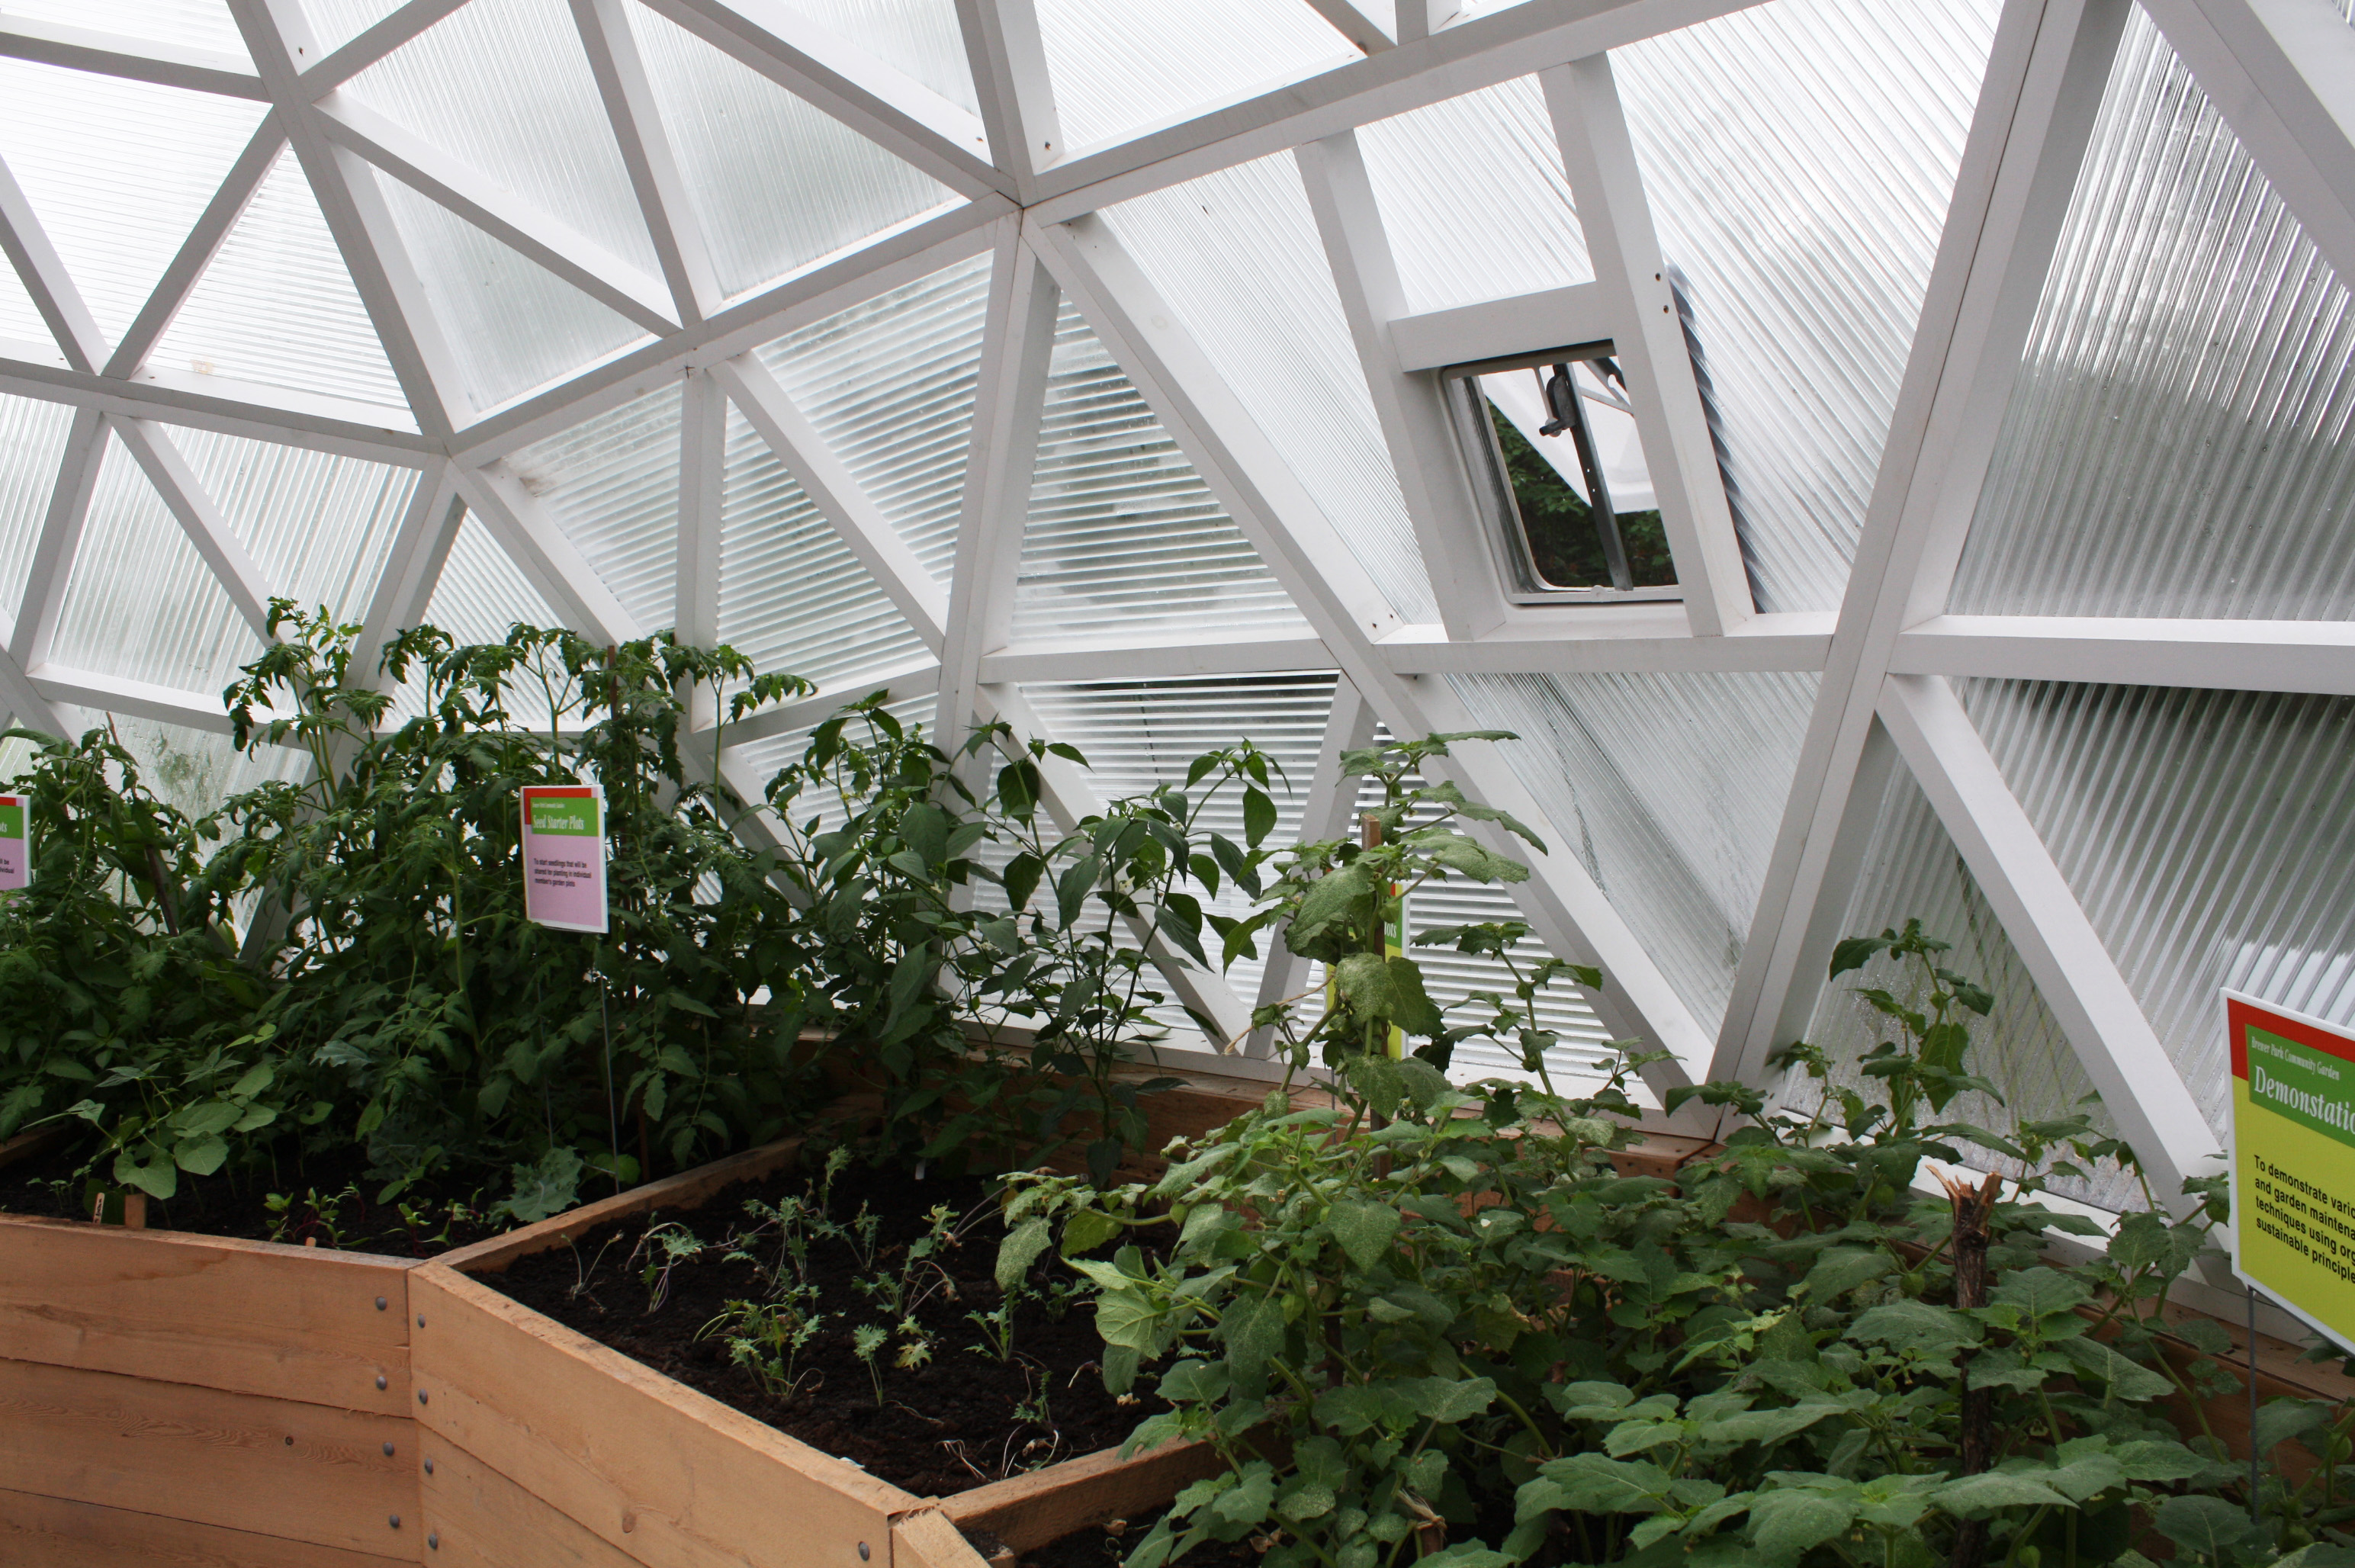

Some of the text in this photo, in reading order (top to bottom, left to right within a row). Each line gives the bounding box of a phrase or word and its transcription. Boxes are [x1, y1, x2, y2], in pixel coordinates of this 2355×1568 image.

[533, 814, 585, 831] Seed Starter Plots
[2251, 1036, 2340, 1081] Brewer Park Community Garden
[2254, 1154, 2266, 1172] To
[2268, 1163, 2328, 1204] demonstrate
[2255, 1178, 2355, 1241] and garden maintena
[2256, 1195, 2306, 1235] techniques
[2309, 1227, 2337, 1255] using
[2256, 1217, 2355, 1284] sustainable principle
